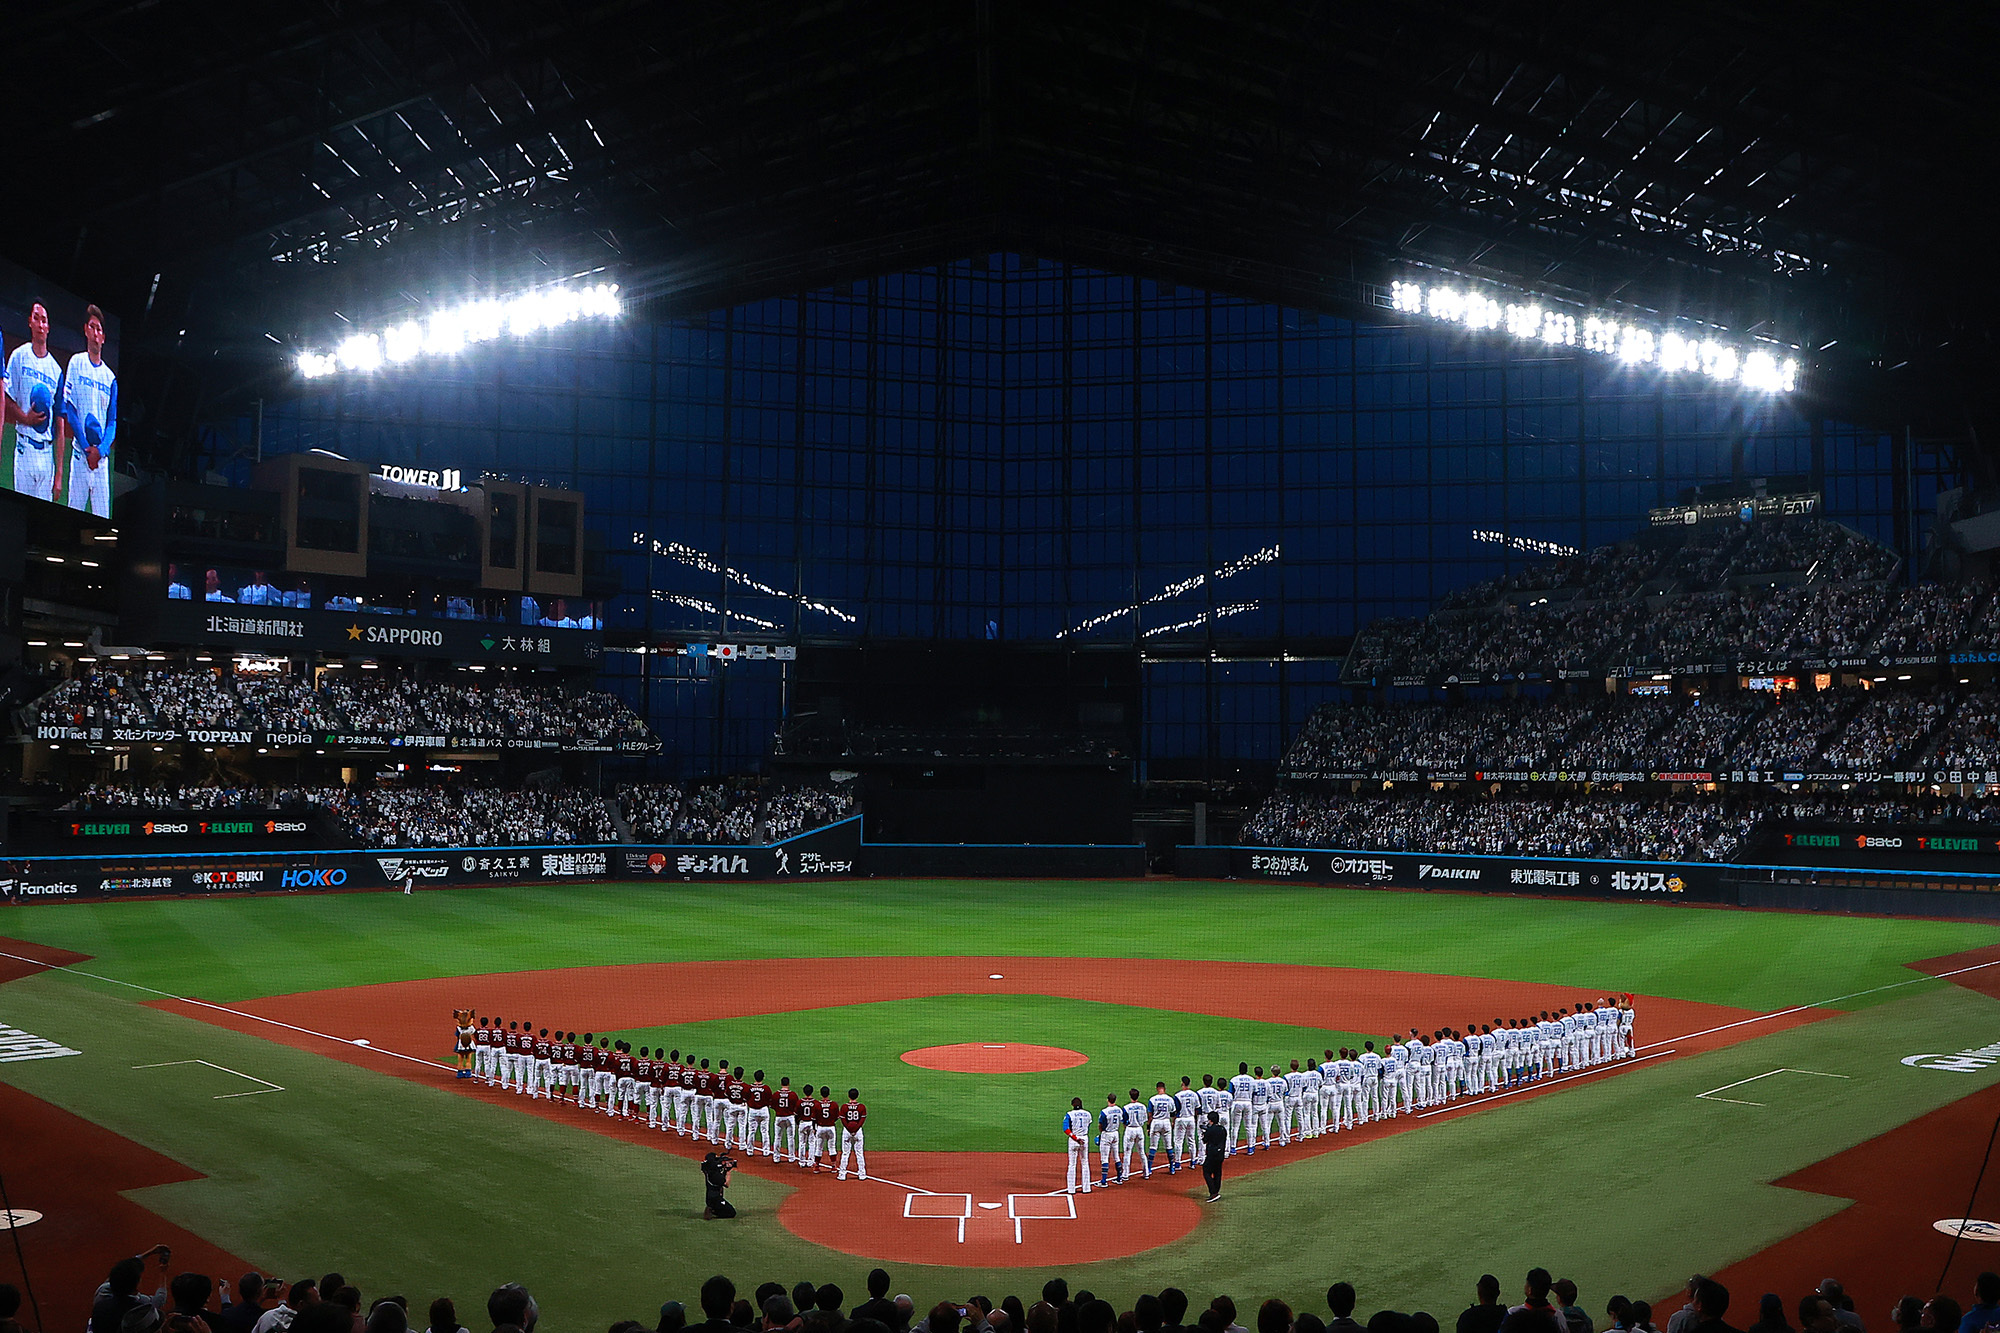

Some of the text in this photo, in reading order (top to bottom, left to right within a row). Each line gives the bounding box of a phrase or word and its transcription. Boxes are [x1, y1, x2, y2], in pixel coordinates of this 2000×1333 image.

[380, 464, 461, 491] TOWER 11
[206, 615, 304, 638] 北海道新聞社
[366, 626, 443, 647] SAPPORO
[502, 635, 551, 653] 大林組
[1895, 655, 1937, 665] SEASON SEAT
[1736, 660, 1792, 673] そらとしば
[187, 730, 253, 743] TOPPAN
[266, 731, 312, 745] nepia
[460, 737, 503, 747] 北海道バス
[114, 754, 129, 771] 11
[1379, 770, 1419, 782] 小山商会
[1731, 771, 1774, 782] 関電工
[1949, 771, 1998, 783] 田中組
[153, 823, 188, 833] sato
[274, 822, 306, 832] sato
[1866, 837, 1902, 848] sato
[574, 852, 607, 864] ハイスクール
[800, 852, 821, 862] アサヒ
[1251, 854, 1309, 872] まつおかまん
[541, 853, 575, 876] 東進
[677, 854, 749, 873] ぎょれん
[800, 861, 852, 874] スーパードライ
[1345, 859, 1393, 874] オカモト
[203, 871, 264, 884] KOTOBUKI
[489, 870, 519, 878] SAIKYU
[1431, 868, 1480, 880] DAIKIN
[1510, 868, 1580, 887] 東光電気工事
[132, 877, 173, 889] 北海紙管
[1611, 871, 1667, 893] 北ガス
[19, 882, 78, 896] Fanatics
[564, 1050, 574, 1059] 42
[600, 1056, 607, 1065] 7
[620, 1063, 630, 1072] 44
[668, 1070, 679, 1080] 25
[700, 1079, 707, 1088] 8
[718, 1080, 725, 1090] 4
[730, 1089, 741, 1099] 35
[753, 1092, 761, 1101] 3
[779, 1098, 789, 1108] 51
[803, 1106, 811, 1116] 0
[822, 1108, 829, 1118] 5
[847, 1110, 859, 1121] 98
